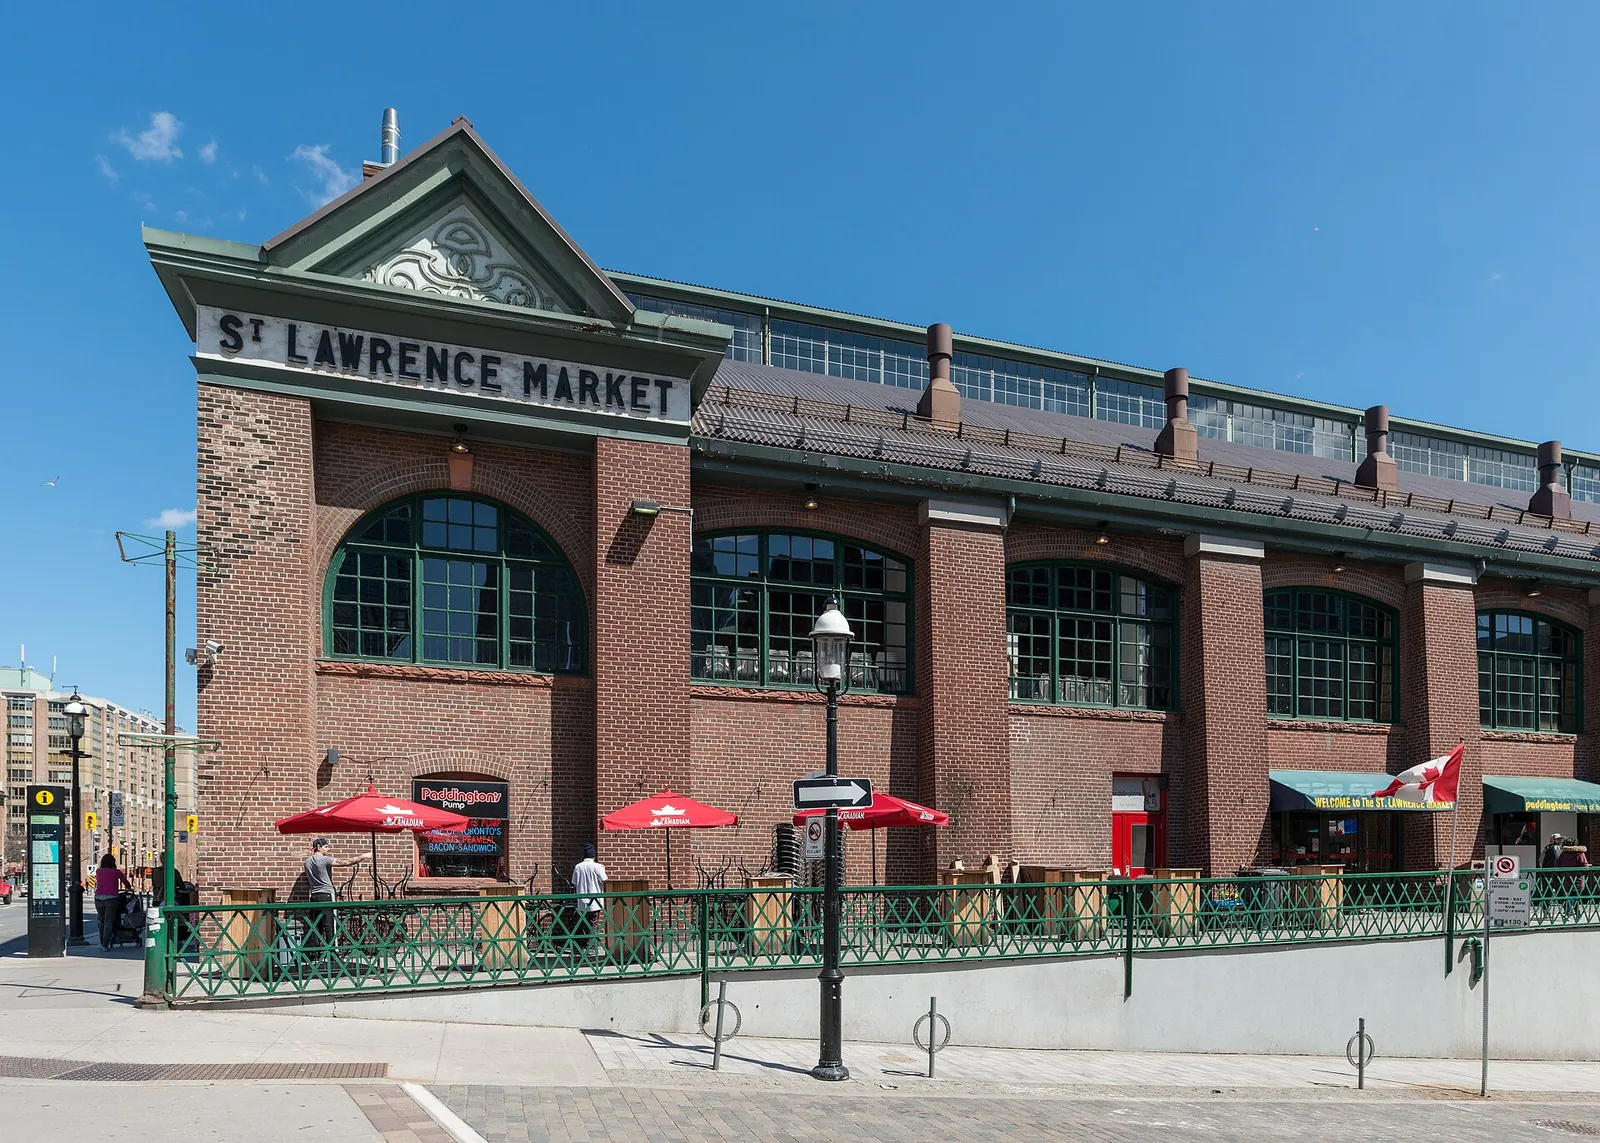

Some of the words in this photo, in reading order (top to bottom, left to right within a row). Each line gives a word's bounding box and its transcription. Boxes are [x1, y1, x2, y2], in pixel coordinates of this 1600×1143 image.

[287, 324, 501, 392] LAWRENCE
[523, 361, 673, 415] MARKET
[421, 787, 501, 805] Paddington's
[442, 801, 465, 810] Pump
[1314, 797, 1350, 808] WELCOME
[1352, 798, 1360, 807] to
[1361, 797, 1374, 807] The
[1375, 797, 1387, 808] ST.
[393, 817, 424, 827] CANADIAN
[462, 836, 496, 844] PEAMEAL
[428, 843, 455, 851] BACON
[458, 843, 497, 852] SANDWICH
